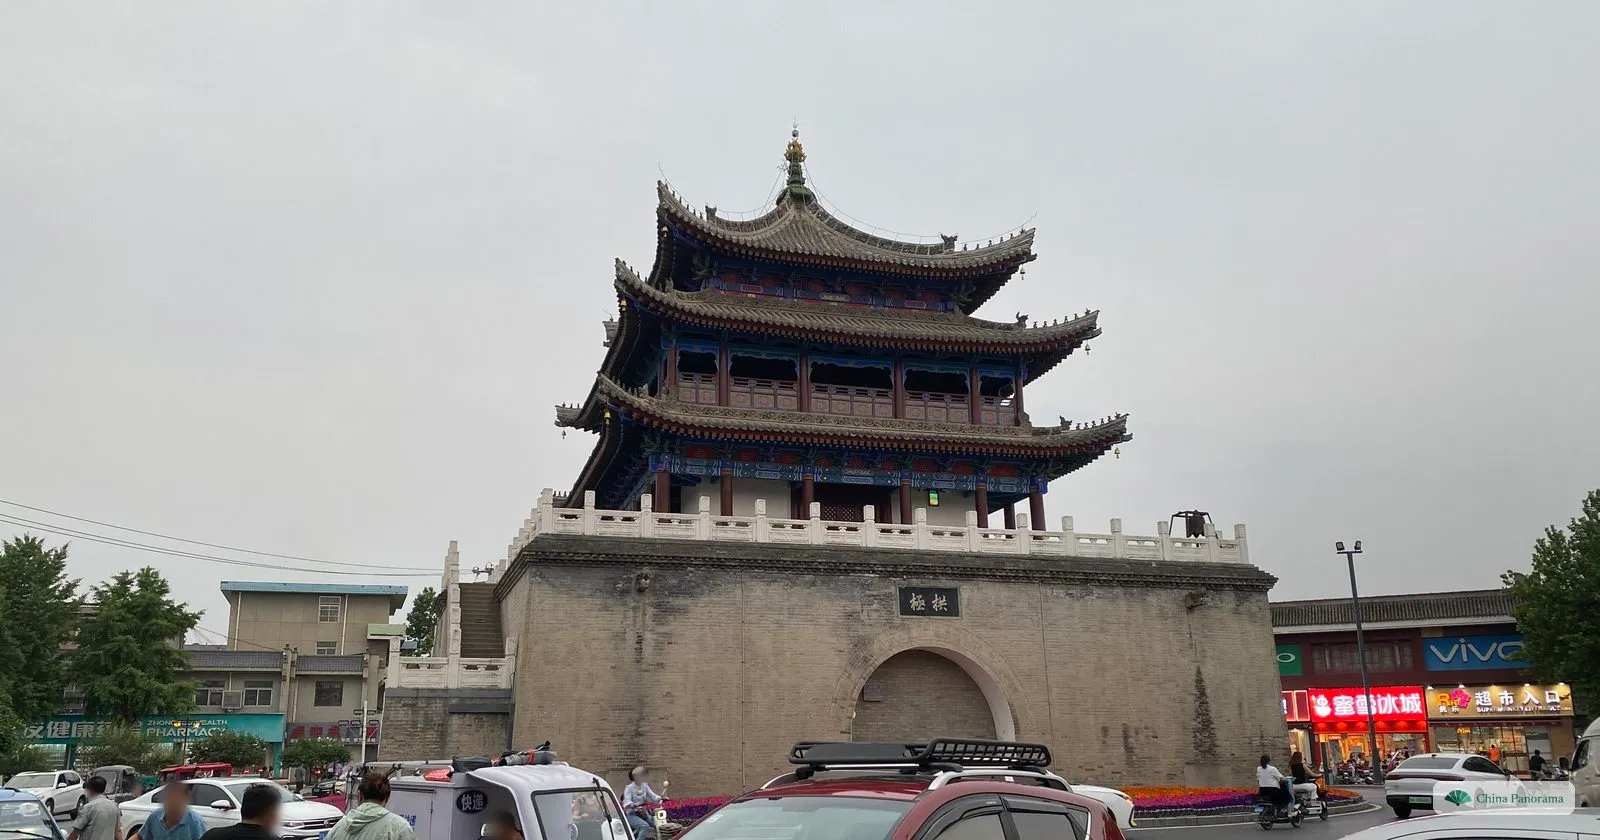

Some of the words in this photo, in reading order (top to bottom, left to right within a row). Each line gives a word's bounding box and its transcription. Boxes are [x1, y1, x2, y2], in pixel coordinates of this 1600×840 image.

[1332, 693, 1422, 716] 蜜雪冰城
[1475, 690, 1560, 706] 超市入口
[146, 728, 226, 737] PHARMACY
[461, 794, 484, 811] 快递
